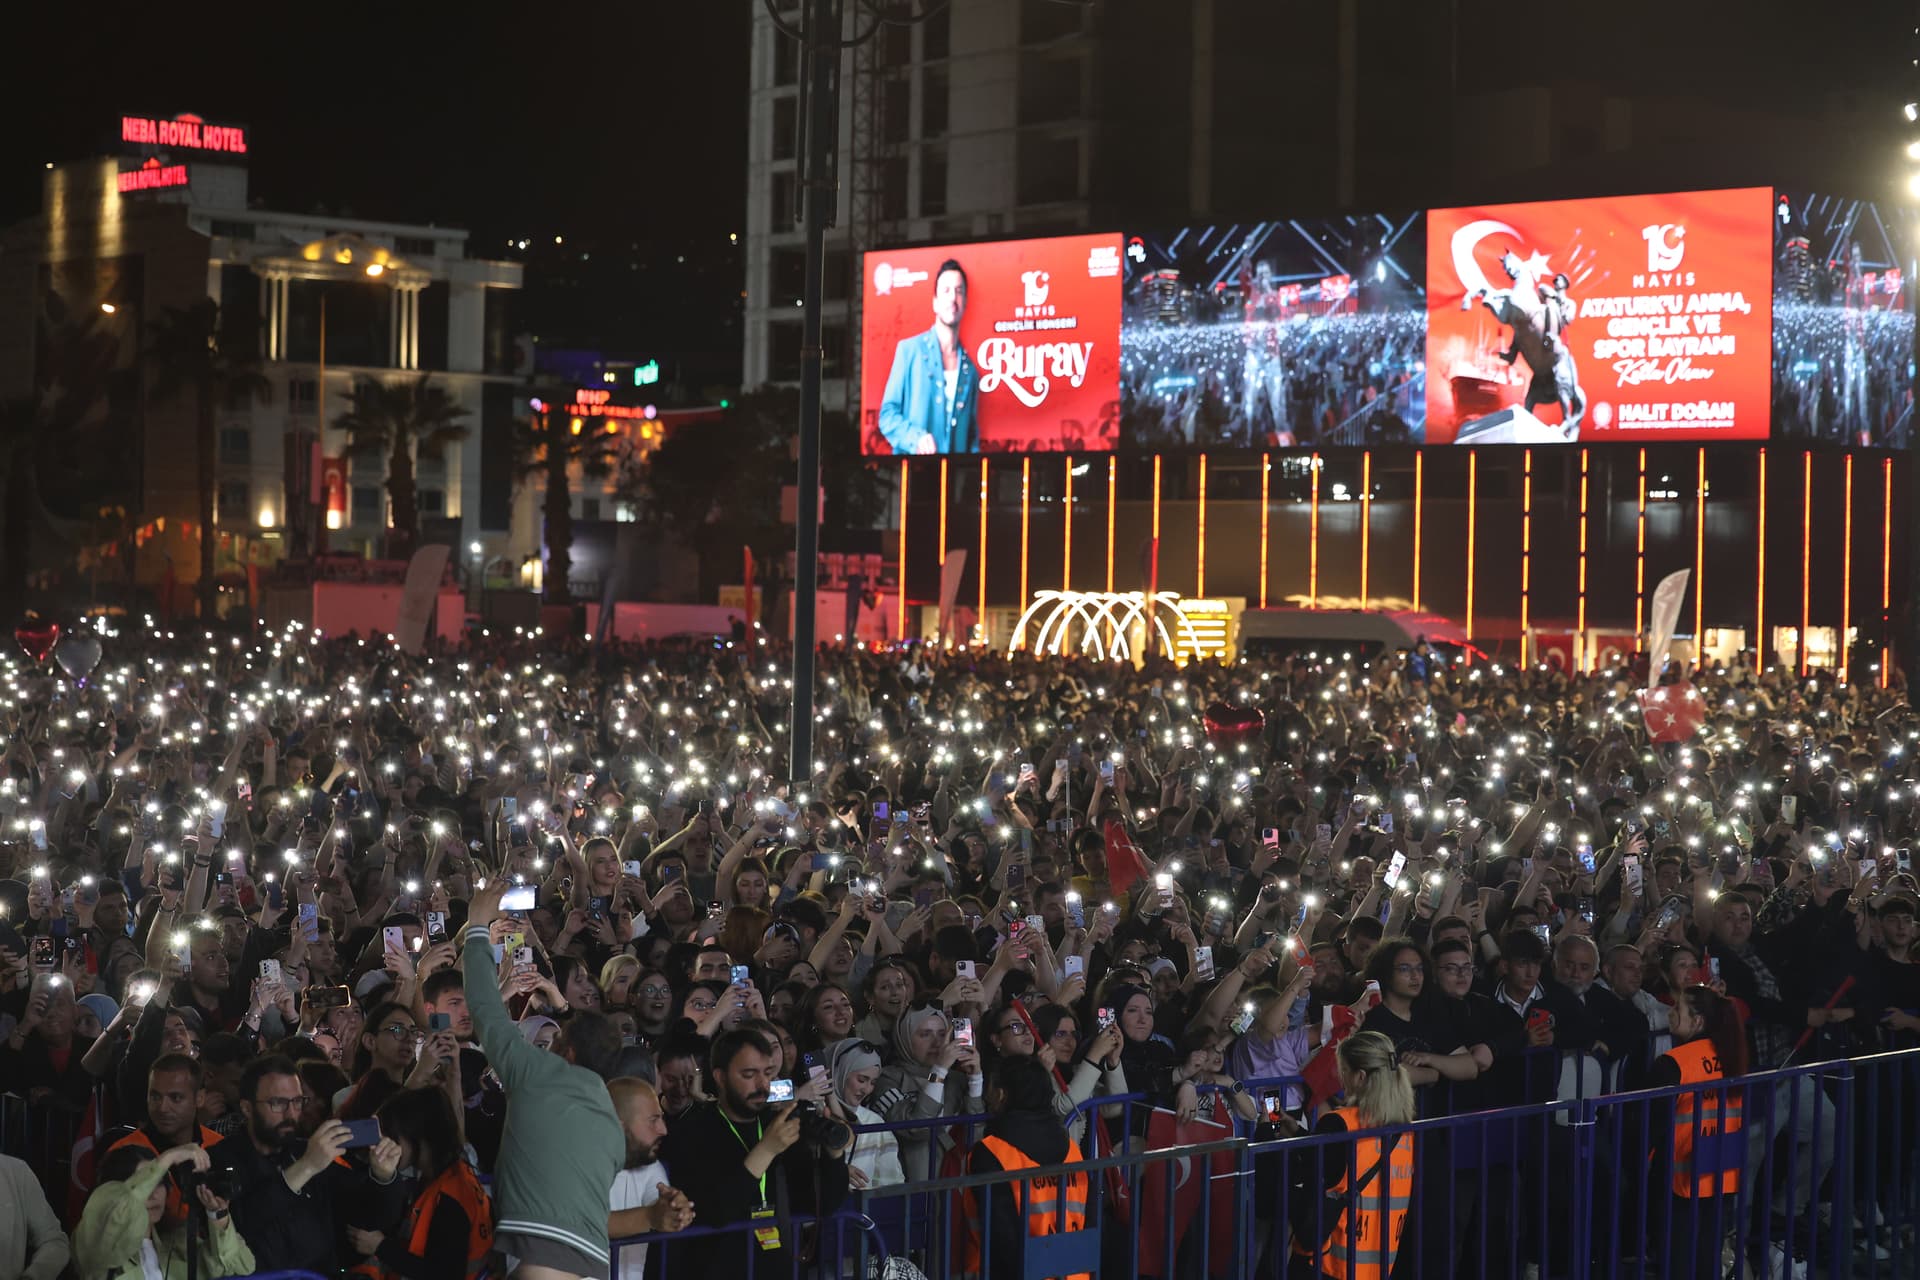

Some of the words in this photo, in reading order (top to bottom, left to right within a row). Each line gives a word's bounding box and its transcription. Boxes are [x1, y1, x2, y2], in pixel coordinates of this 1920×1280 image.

[159, 120, 202, 148] ROYAL
[203, 125, 247, 153] HOTEL
[1693, 314, 1721, 334] VE
[977, 338, 1094, 408] Buray
